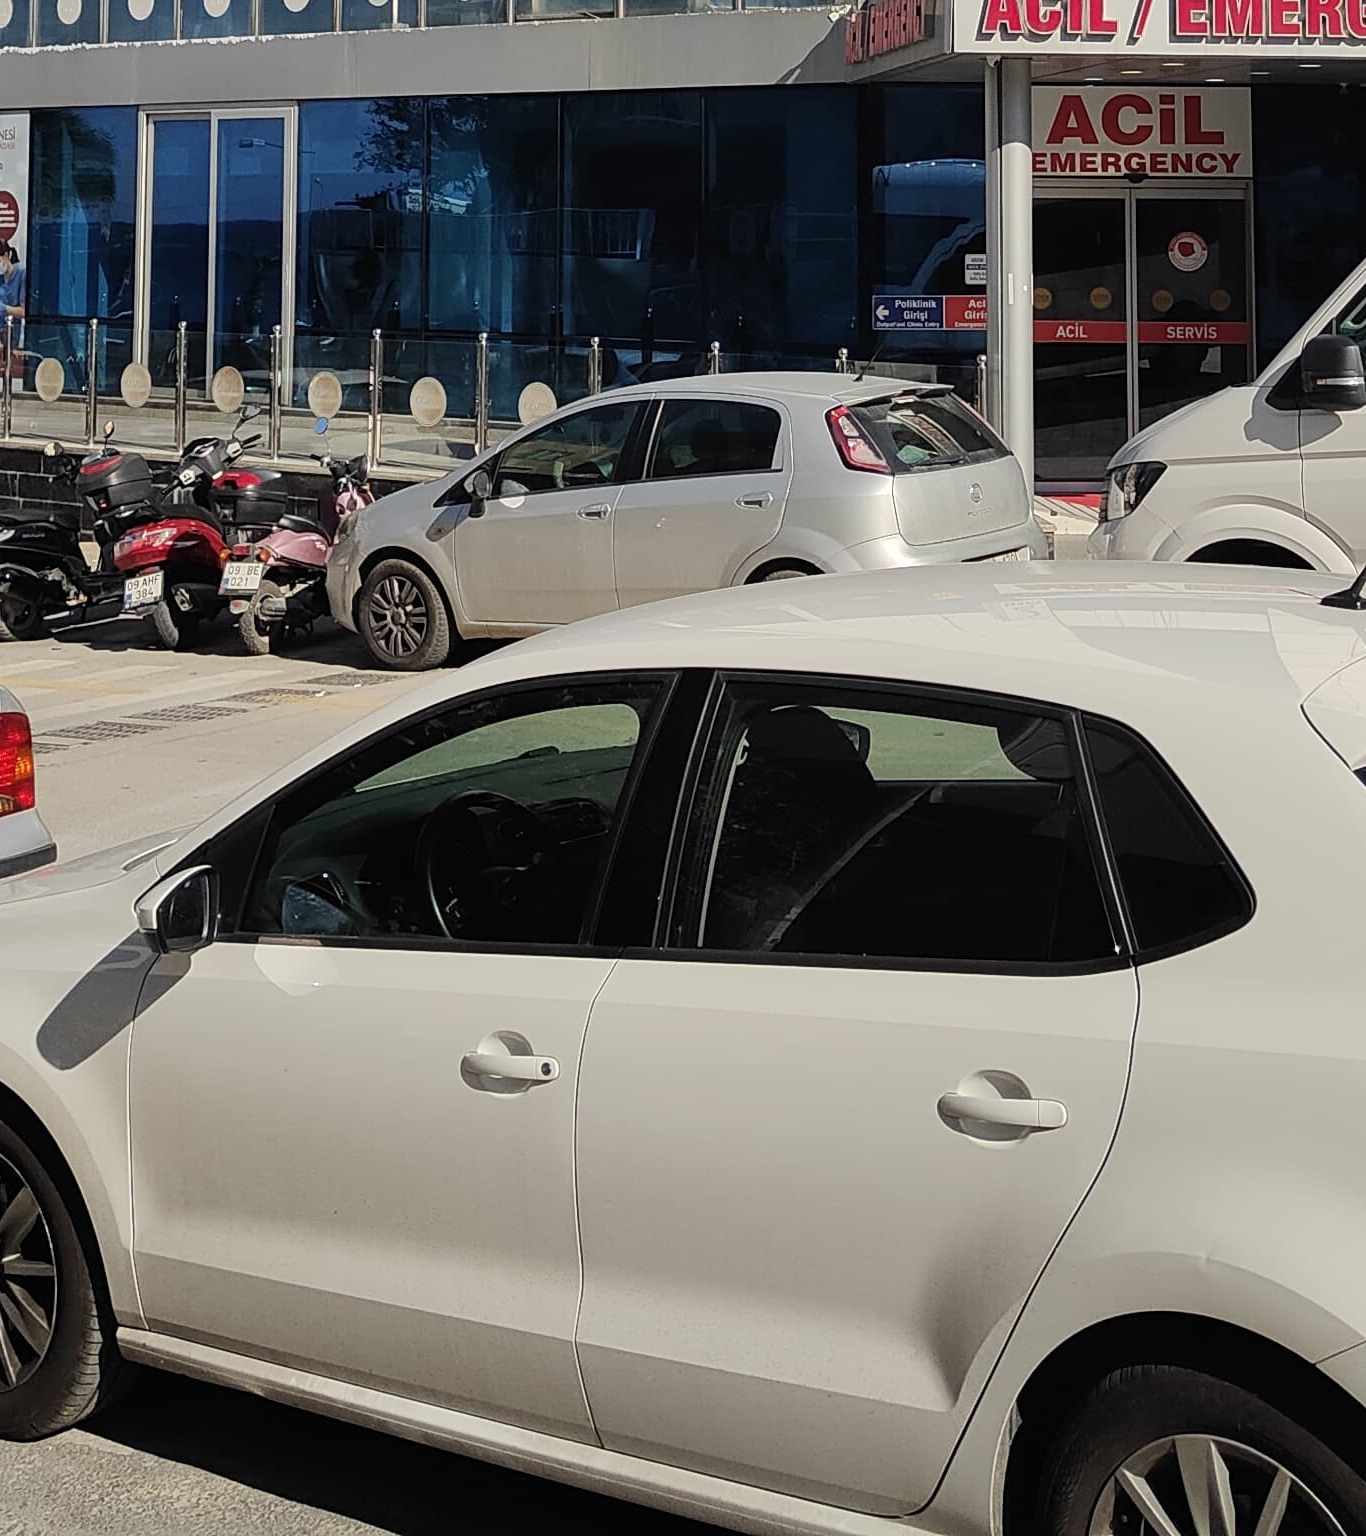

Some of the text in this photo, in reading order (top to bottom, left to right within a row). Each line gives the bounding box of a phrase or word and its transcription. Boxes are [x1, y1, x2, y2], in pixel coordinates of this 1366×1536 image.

[1032, 152, 1242, 174] EMERGENCY
[894, 299, 938, 309] Poliklinik
[903, 310, 929, 322] Girişi
[1166, 325, 1218, 340] SERVİS
[228, 565, 241, 575] 09
[127, 574, 160, 591] 09 AHF
[230, 576, 249, 587] 021
